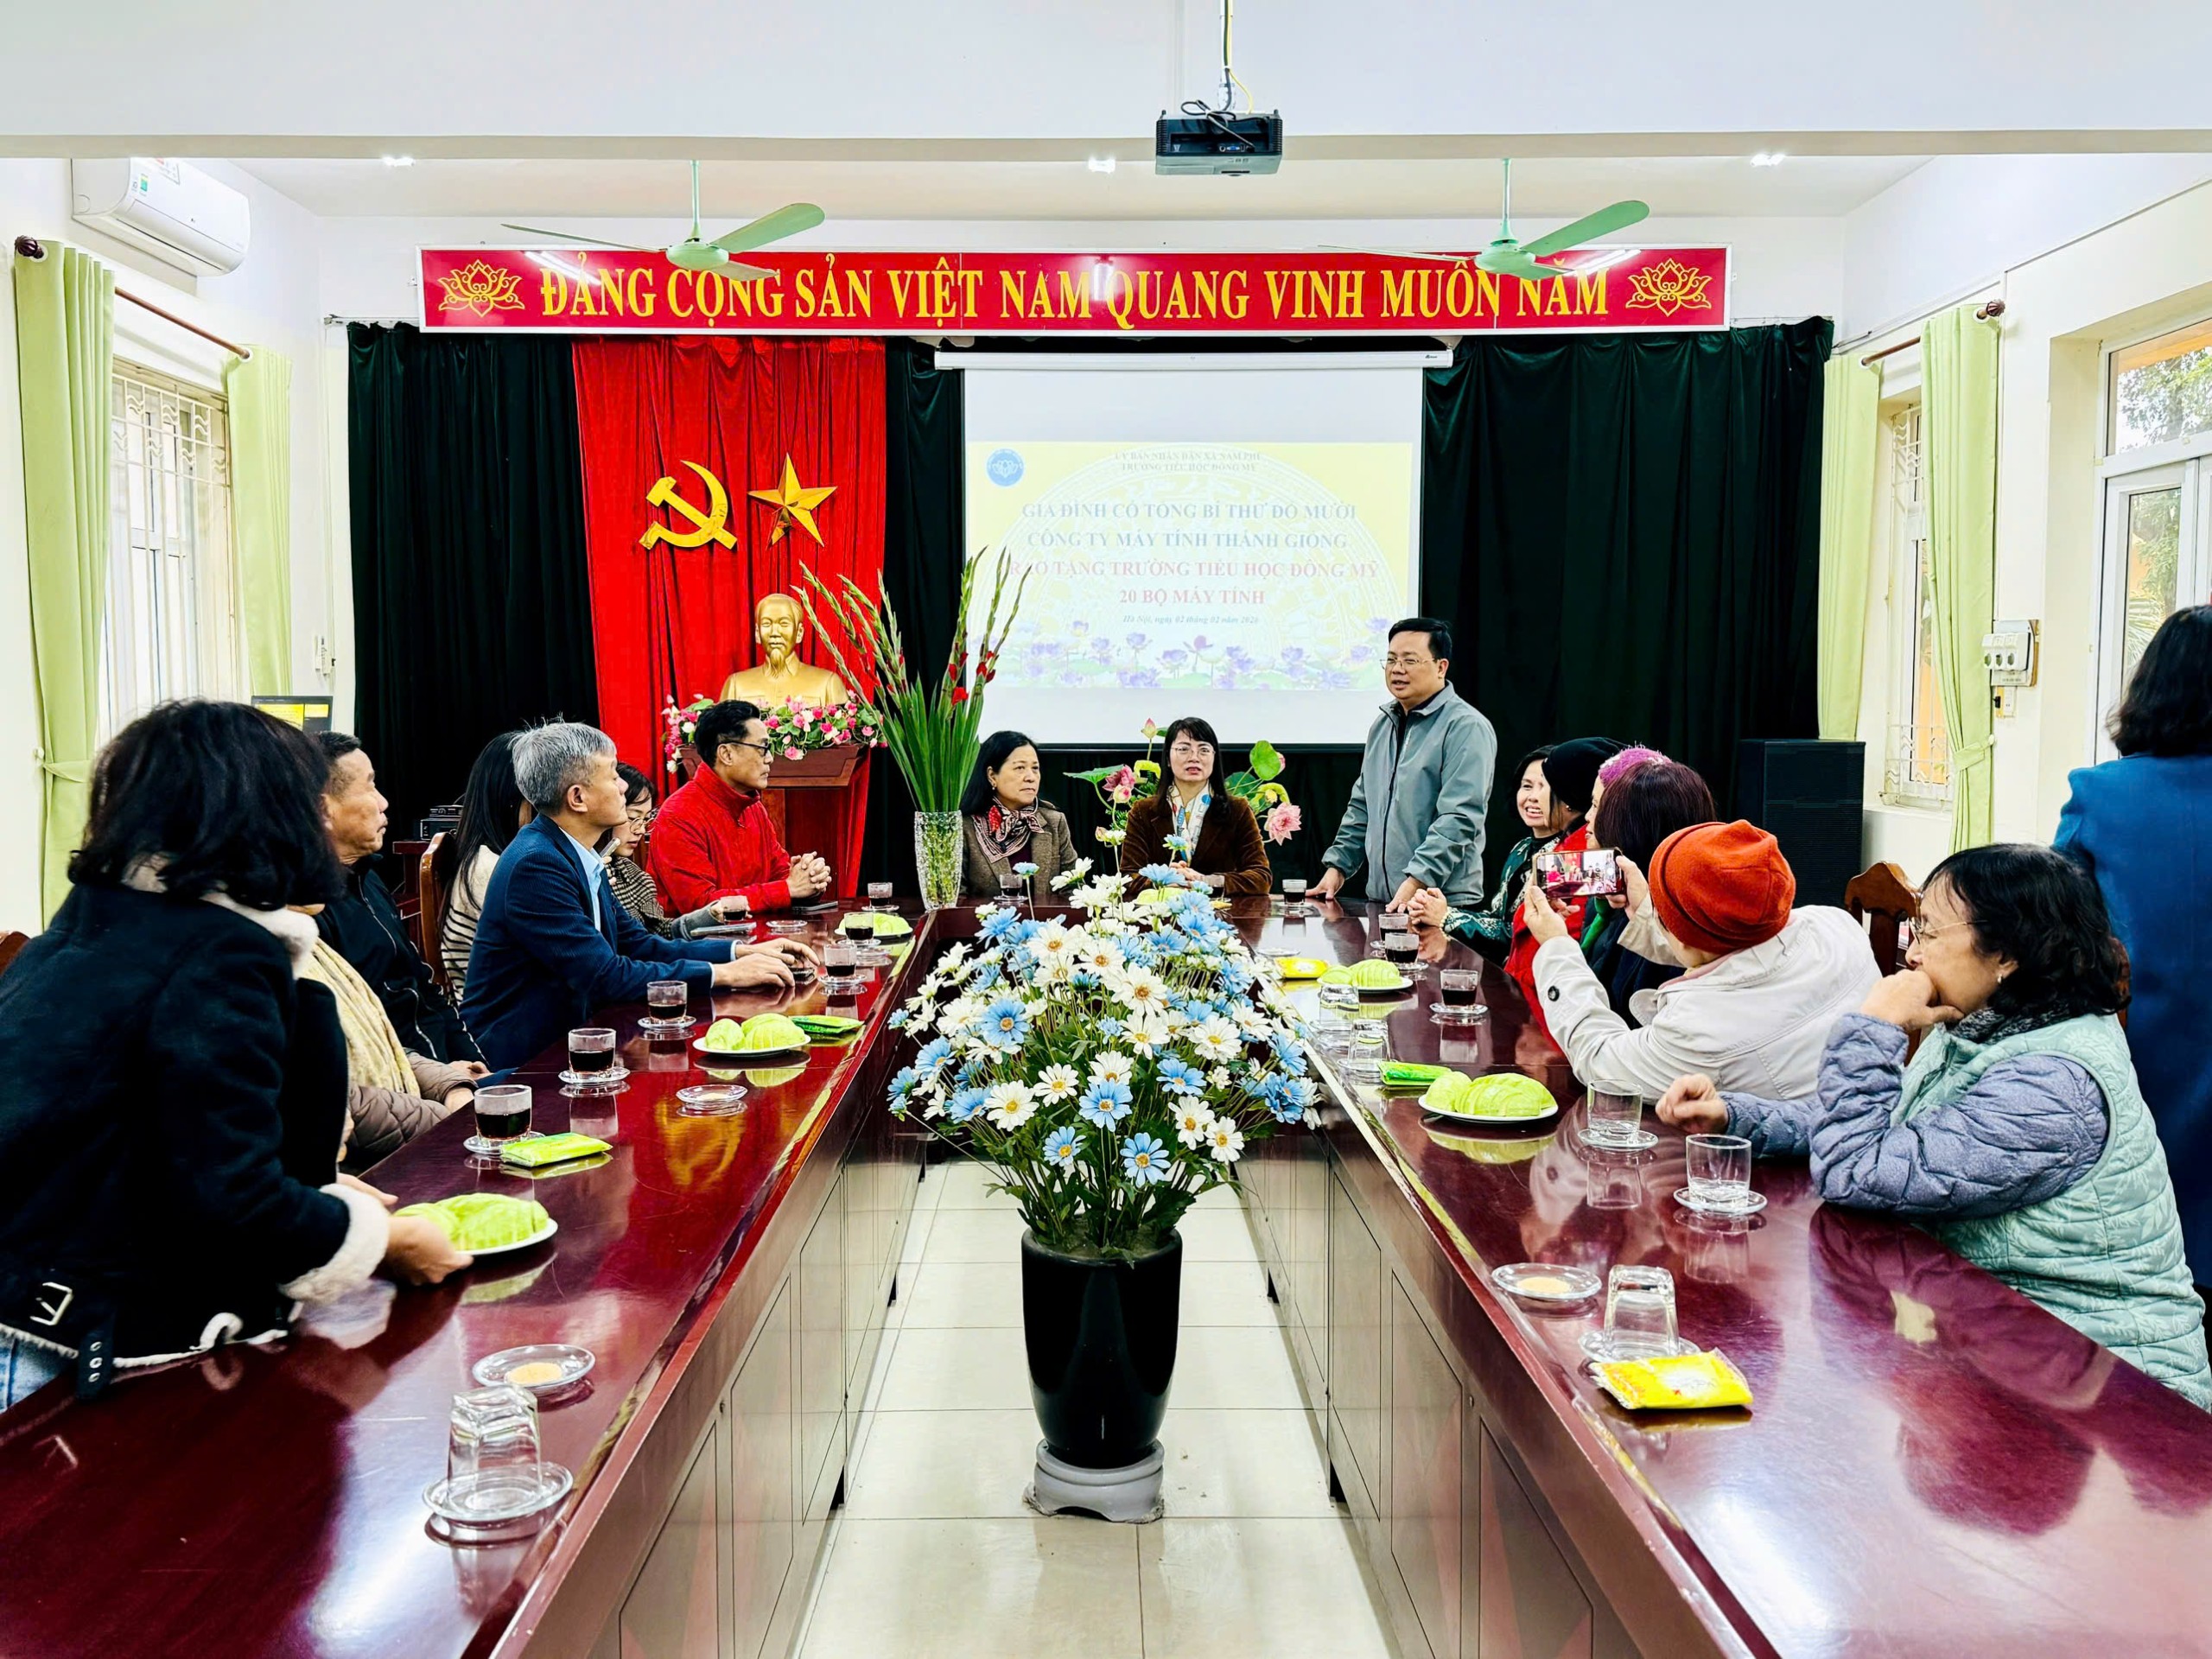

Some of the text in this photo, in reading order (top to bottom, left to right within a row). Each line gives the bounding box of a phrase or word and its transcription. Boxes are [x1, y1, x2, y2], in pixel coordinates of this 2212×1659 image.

[540, 251, 654, 316] ĐẢNG
[795, 252, 873, 319] SẢN
[887, 256, 983, 327] VIỆT
[1000, 270, 1090, 319] NAM
[1105, 270, 1249, 329] QUANG
[1263, 270, 1365, 320] VINH
[1380, 260, 1500, 318] MUÔN
[1516, 257, 1610, 316] NĂM
[1022, 503, 1056, 518] GIA
[1203, 500, 1220, 518] BÍ
[1225, 502, 1268, 518] THƯ
[1027, 529, 1080, 547] CÔNG
[1086, 532, 1109, 547] TY
[1116, 529, 1159, 547] MÁY
[1163, 528, 1208, 547] TÍNH
[1212, 528, 1279, 548] THÁNH
[1109, 557, 1190, 576] TRƯỜNG
[1244, 563, 1284, 579] HỌC
[1119, 586, 1266, 607] 20 BỘ MÁY TÍNH
